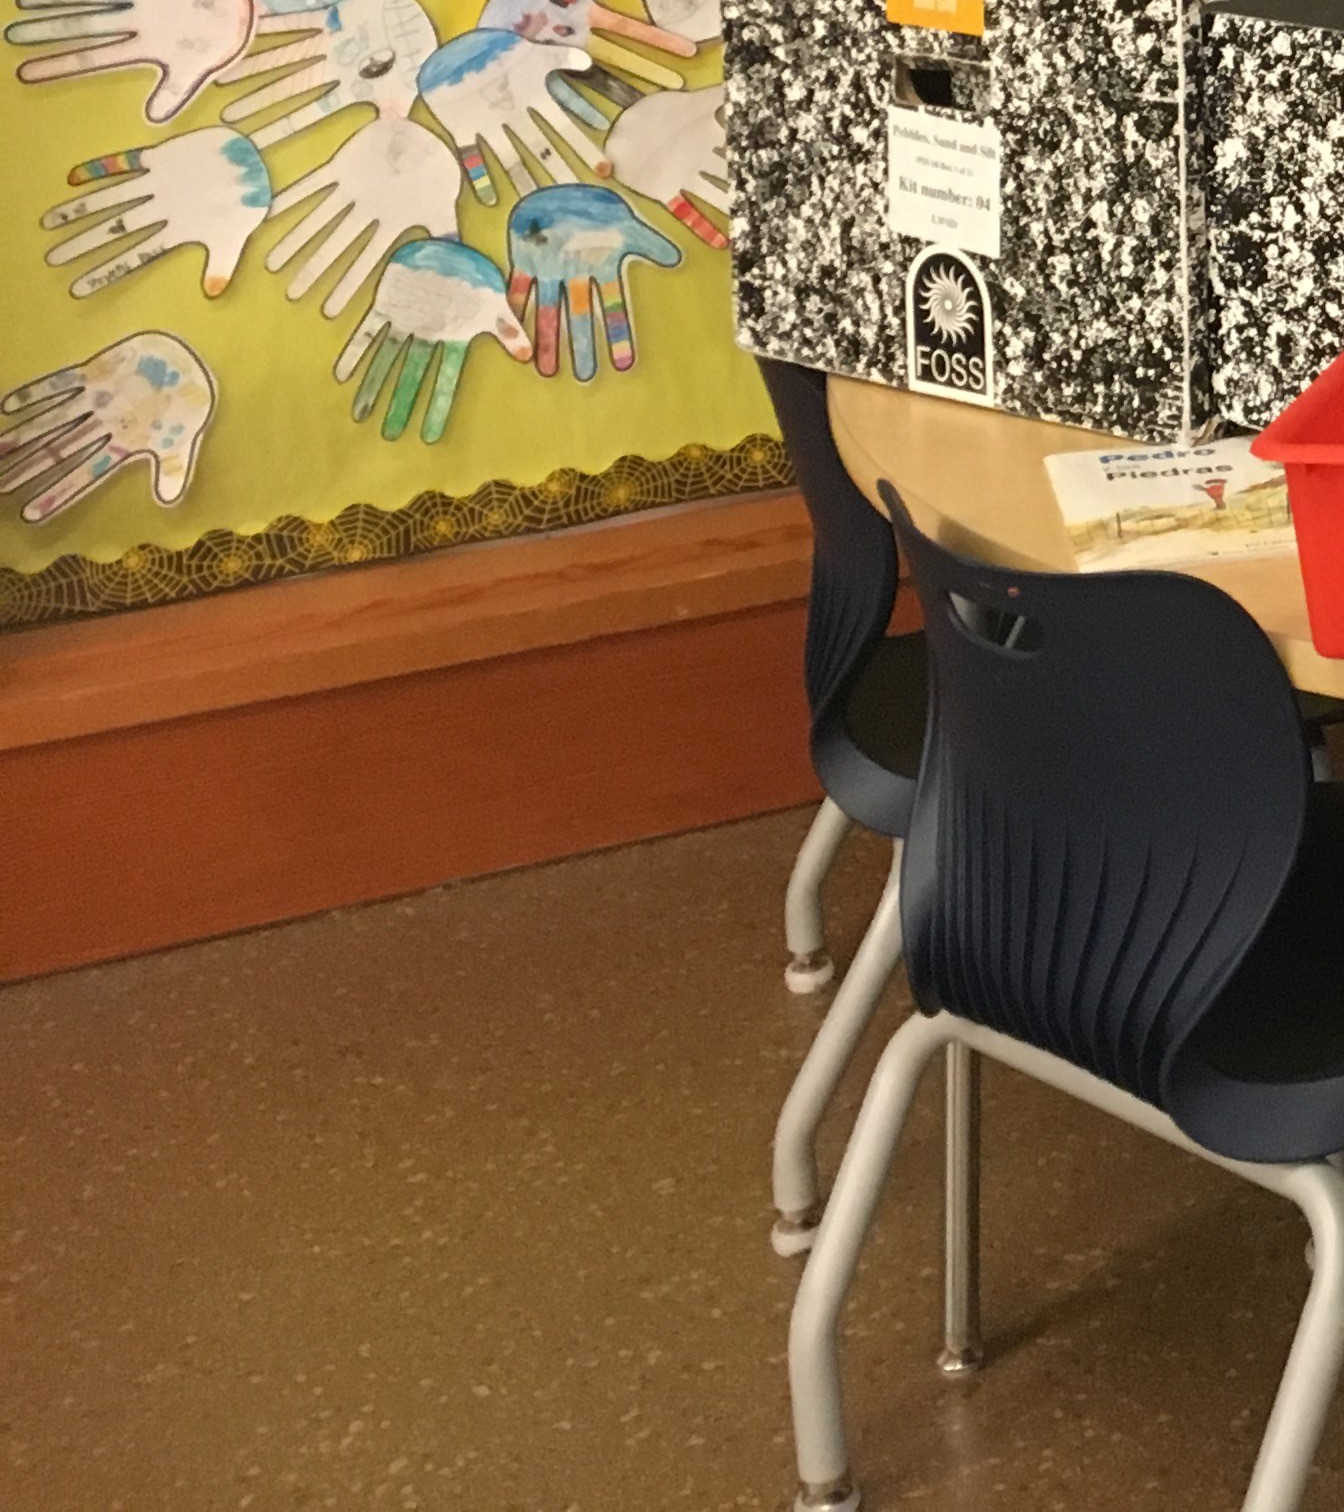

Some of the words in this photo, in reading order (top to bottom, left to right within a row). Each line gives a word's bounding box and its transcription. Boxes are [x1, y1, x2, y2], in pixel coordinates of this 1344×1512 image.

[899, 176, 917, 194] Kit
[921, 185, 973, 208] number:
[976, 195, 990, 212] 04
[917, 345, 985, 390] FOSS
[1099, 448, 1216, 464] Pedro
[1106, 465, 1234, 481] Piedras
